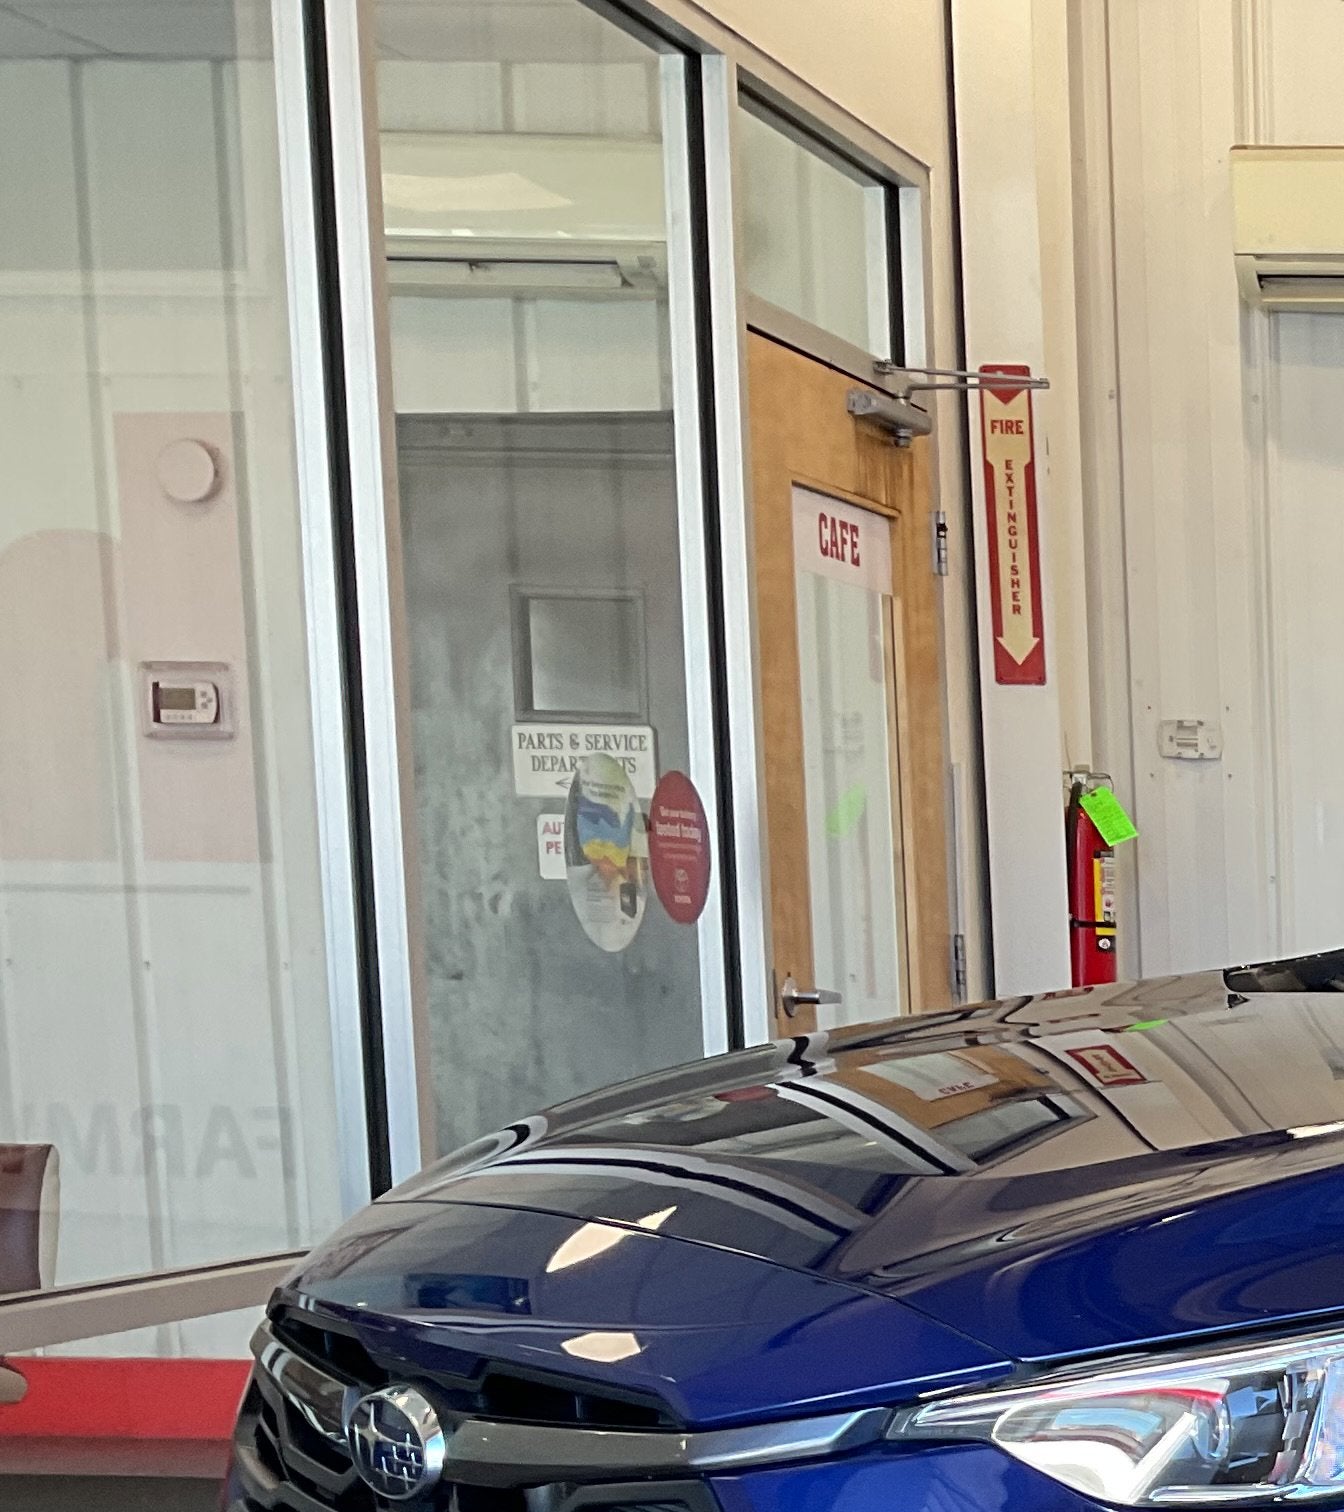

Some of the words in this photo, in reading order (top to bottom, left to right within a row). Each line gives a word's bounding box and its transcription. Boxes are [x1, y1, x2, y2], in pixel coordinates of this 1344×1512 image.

[990, 419, 1025, 436] FIRE
[818, 512, 861, 568] CAFE
[1004, 458, 1021, 616] EXTINGUISHER
[517, 732, 563, 749] PARTS
[569, 733, 580, 749] &
[585, 734, 647, 751] SERVICE
